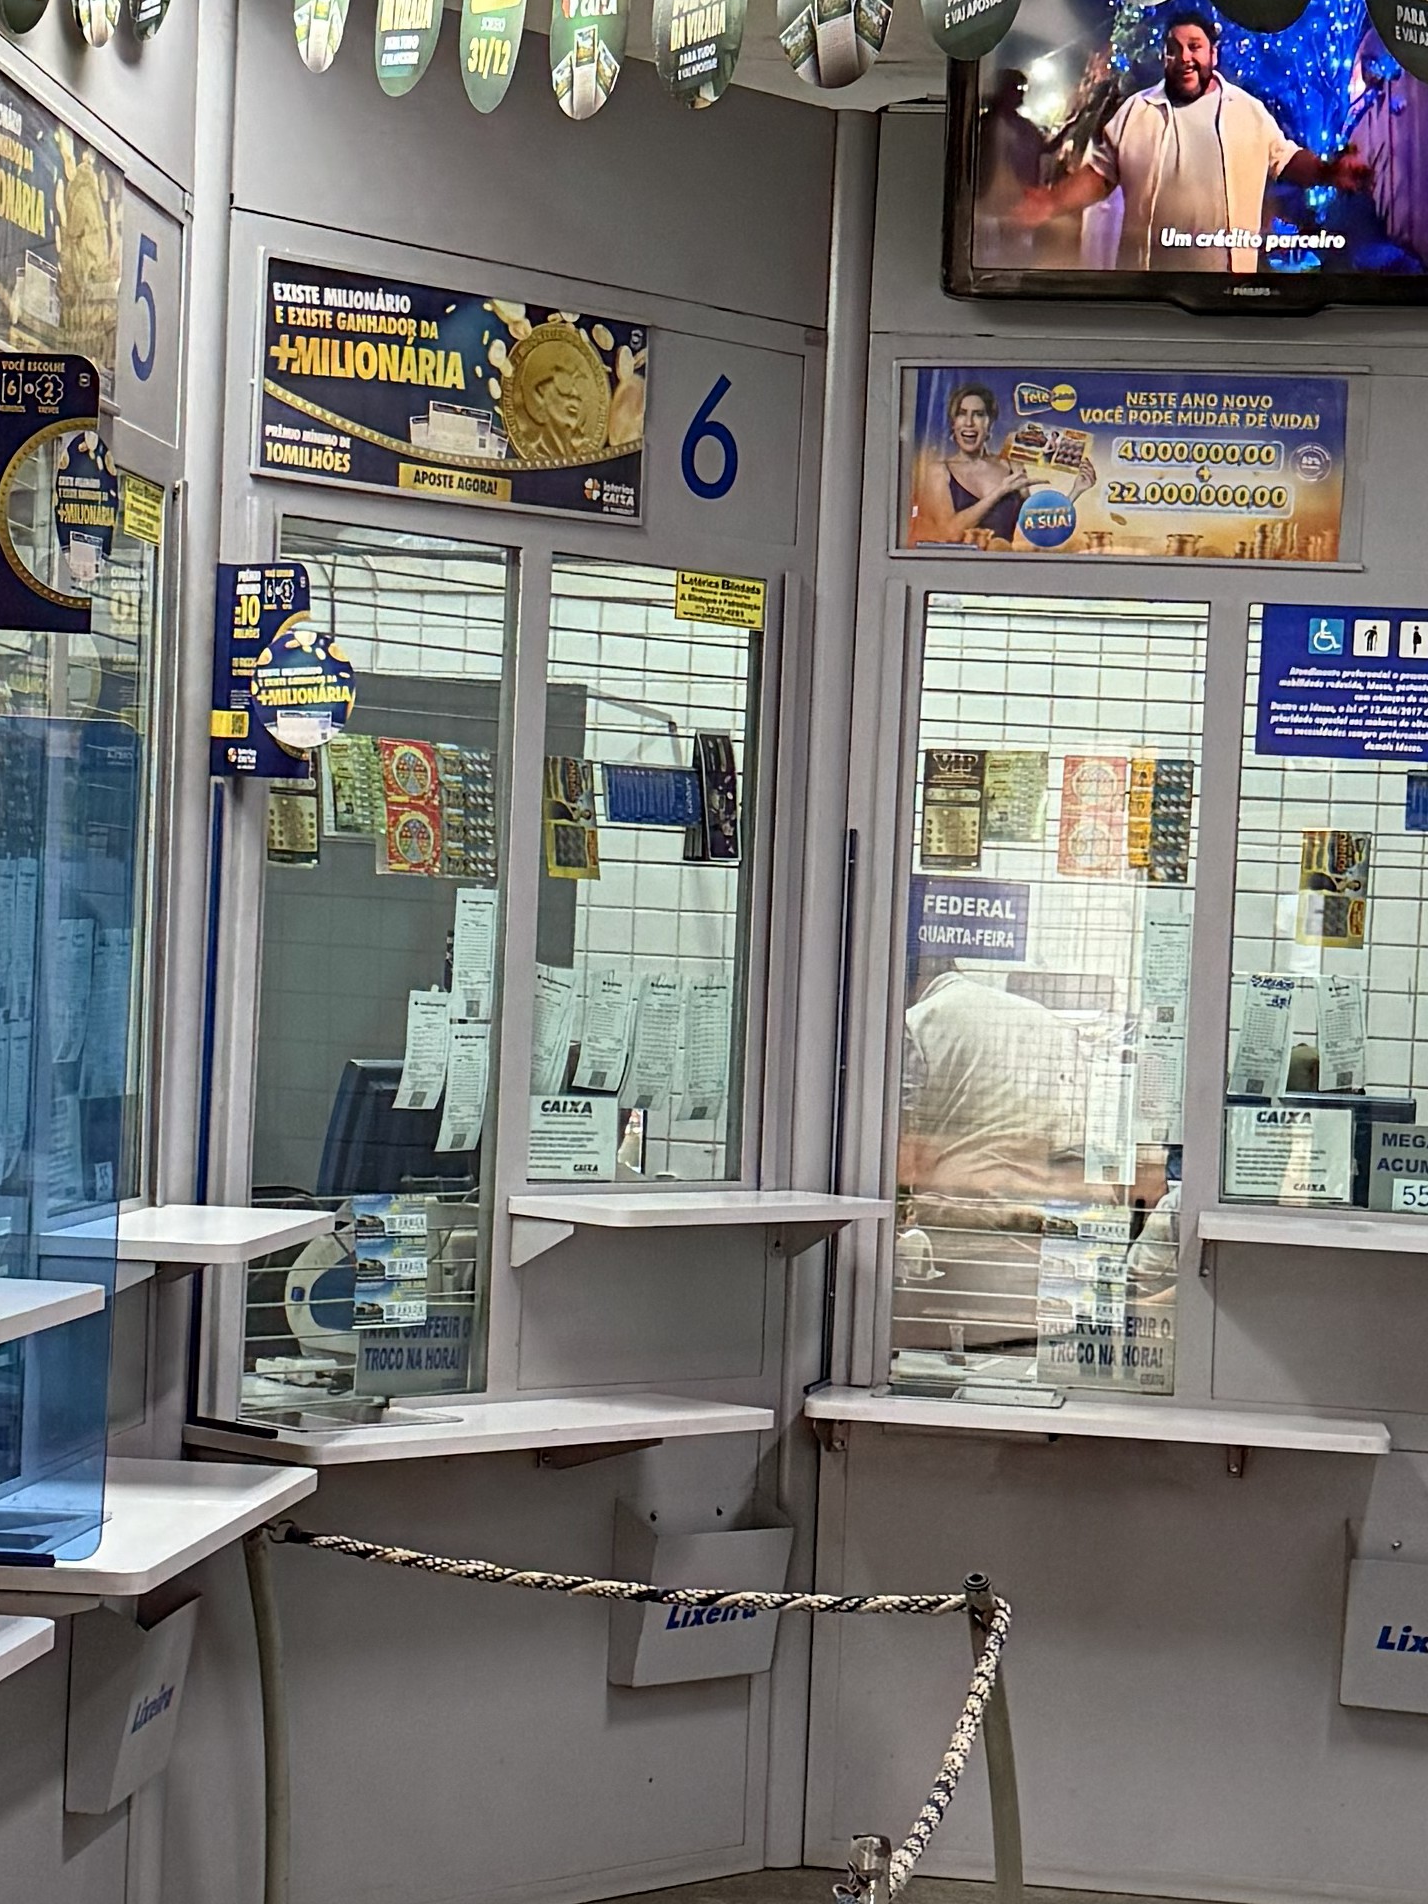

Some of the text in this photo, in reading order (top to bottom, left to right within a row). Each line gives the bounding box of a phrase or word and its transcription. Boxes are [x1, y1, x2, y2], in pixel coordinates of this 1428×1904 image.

[1161, 228, 1346, 252] Um crédito parceiro
[131, 233, 158, 381] 5
[273, 282, 411, 314] EXISTE MILIONÁRIO
[276, 308, 439, 339] E EXISTE GANHADOR DA
[270, 334, 465, 390] +MILIONÁRIA
[1127, 392, 1272, 410] NESTE ANO NOVO
[1080, 406, 1320, 430] VOCÊ PODE MUDAR DE VIDA!
[680, 374, 738, 499] 6
[414, 471, 497, 496] APOSTE AGORA!
[924, 895, 1016, 919] FEDERAL
[919, 925, 1014, 948] QUARTA-FEIRA
[365, 1348, 460, 1370] TROCO NA HORA!
